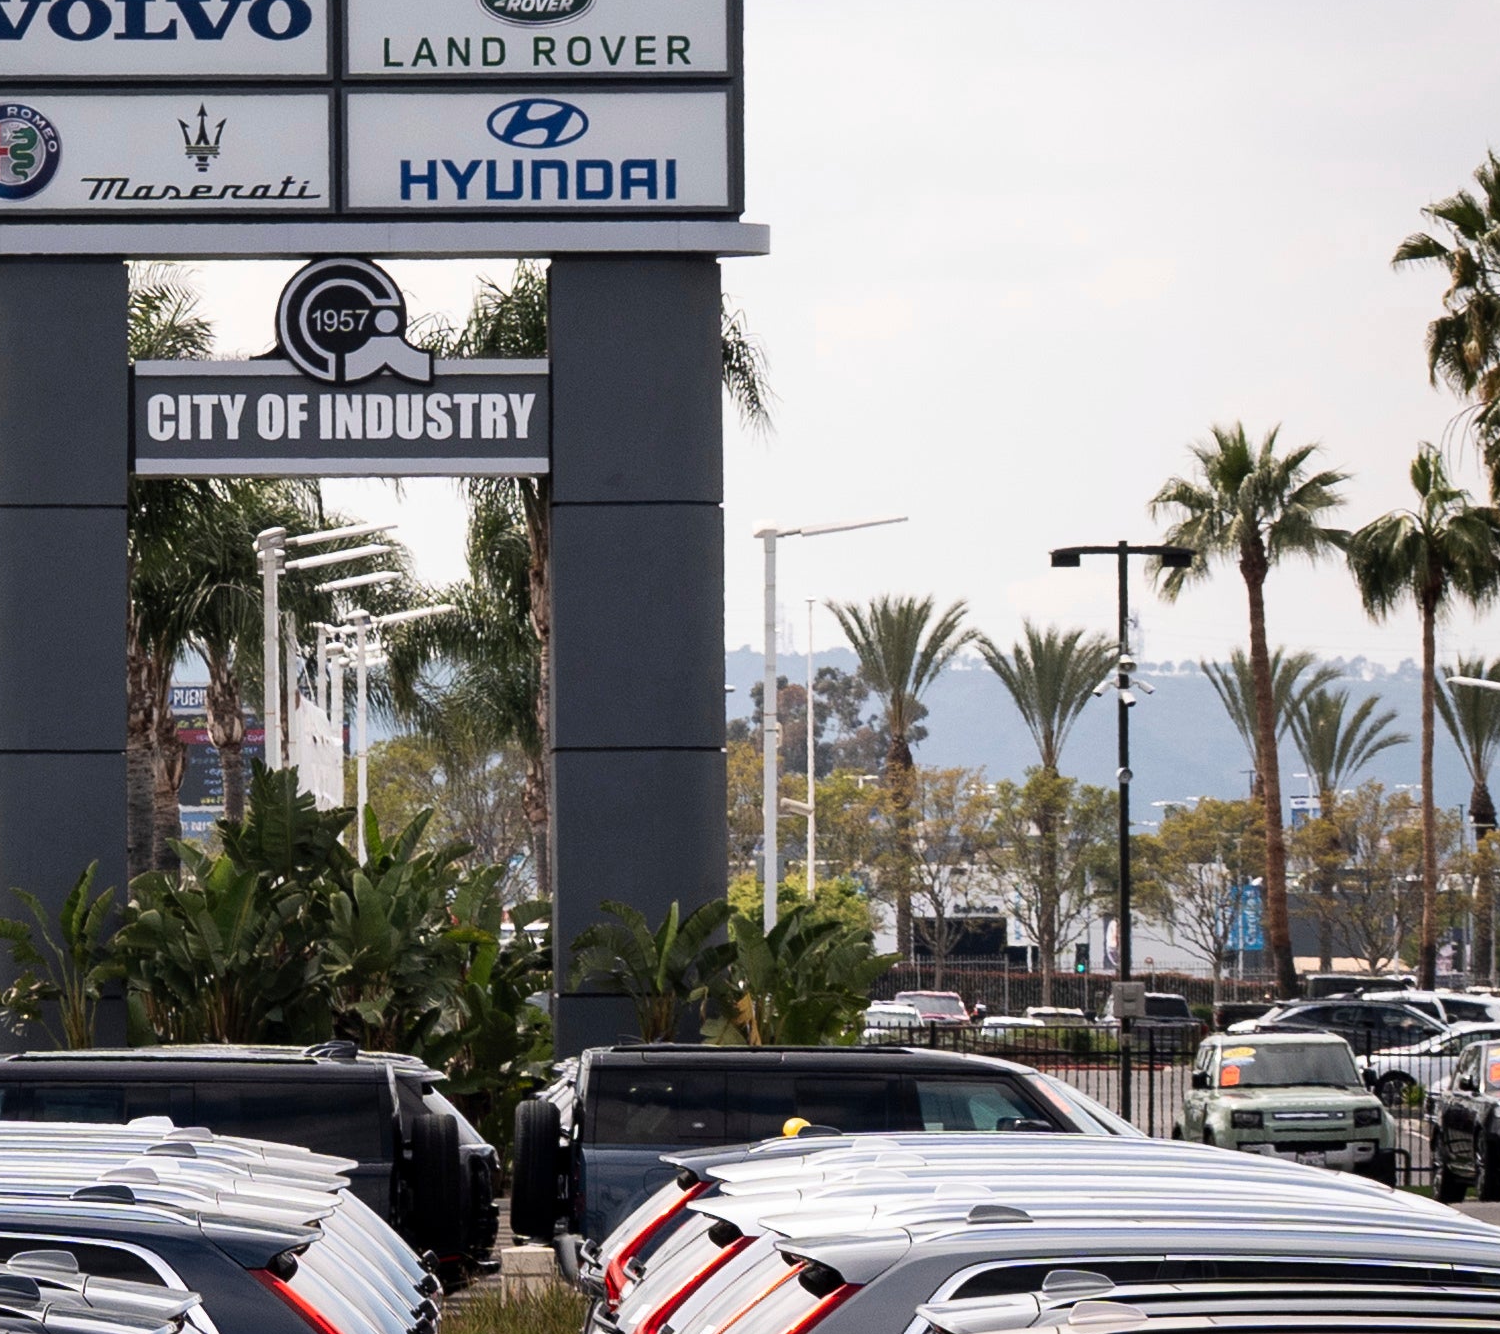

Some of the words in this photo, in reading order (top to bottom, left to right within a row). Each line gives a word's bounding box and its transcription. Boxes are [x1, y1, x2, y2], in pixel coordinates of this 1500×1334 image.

[382, 36, 508, 69] LAND
[532, 34, 694, 67] ROVER
[6, 105, 59, 154] ROMEO
[80, 175, 322, 201] Maserati
[399, 158, 678, 201] HYUNDAI
[310, 307, 371, 333] 1957
[145, 392, 249, 441] CITY
[256, 392, 311, 441] OF
[318, 392, 537, 441] INDUSTRY
